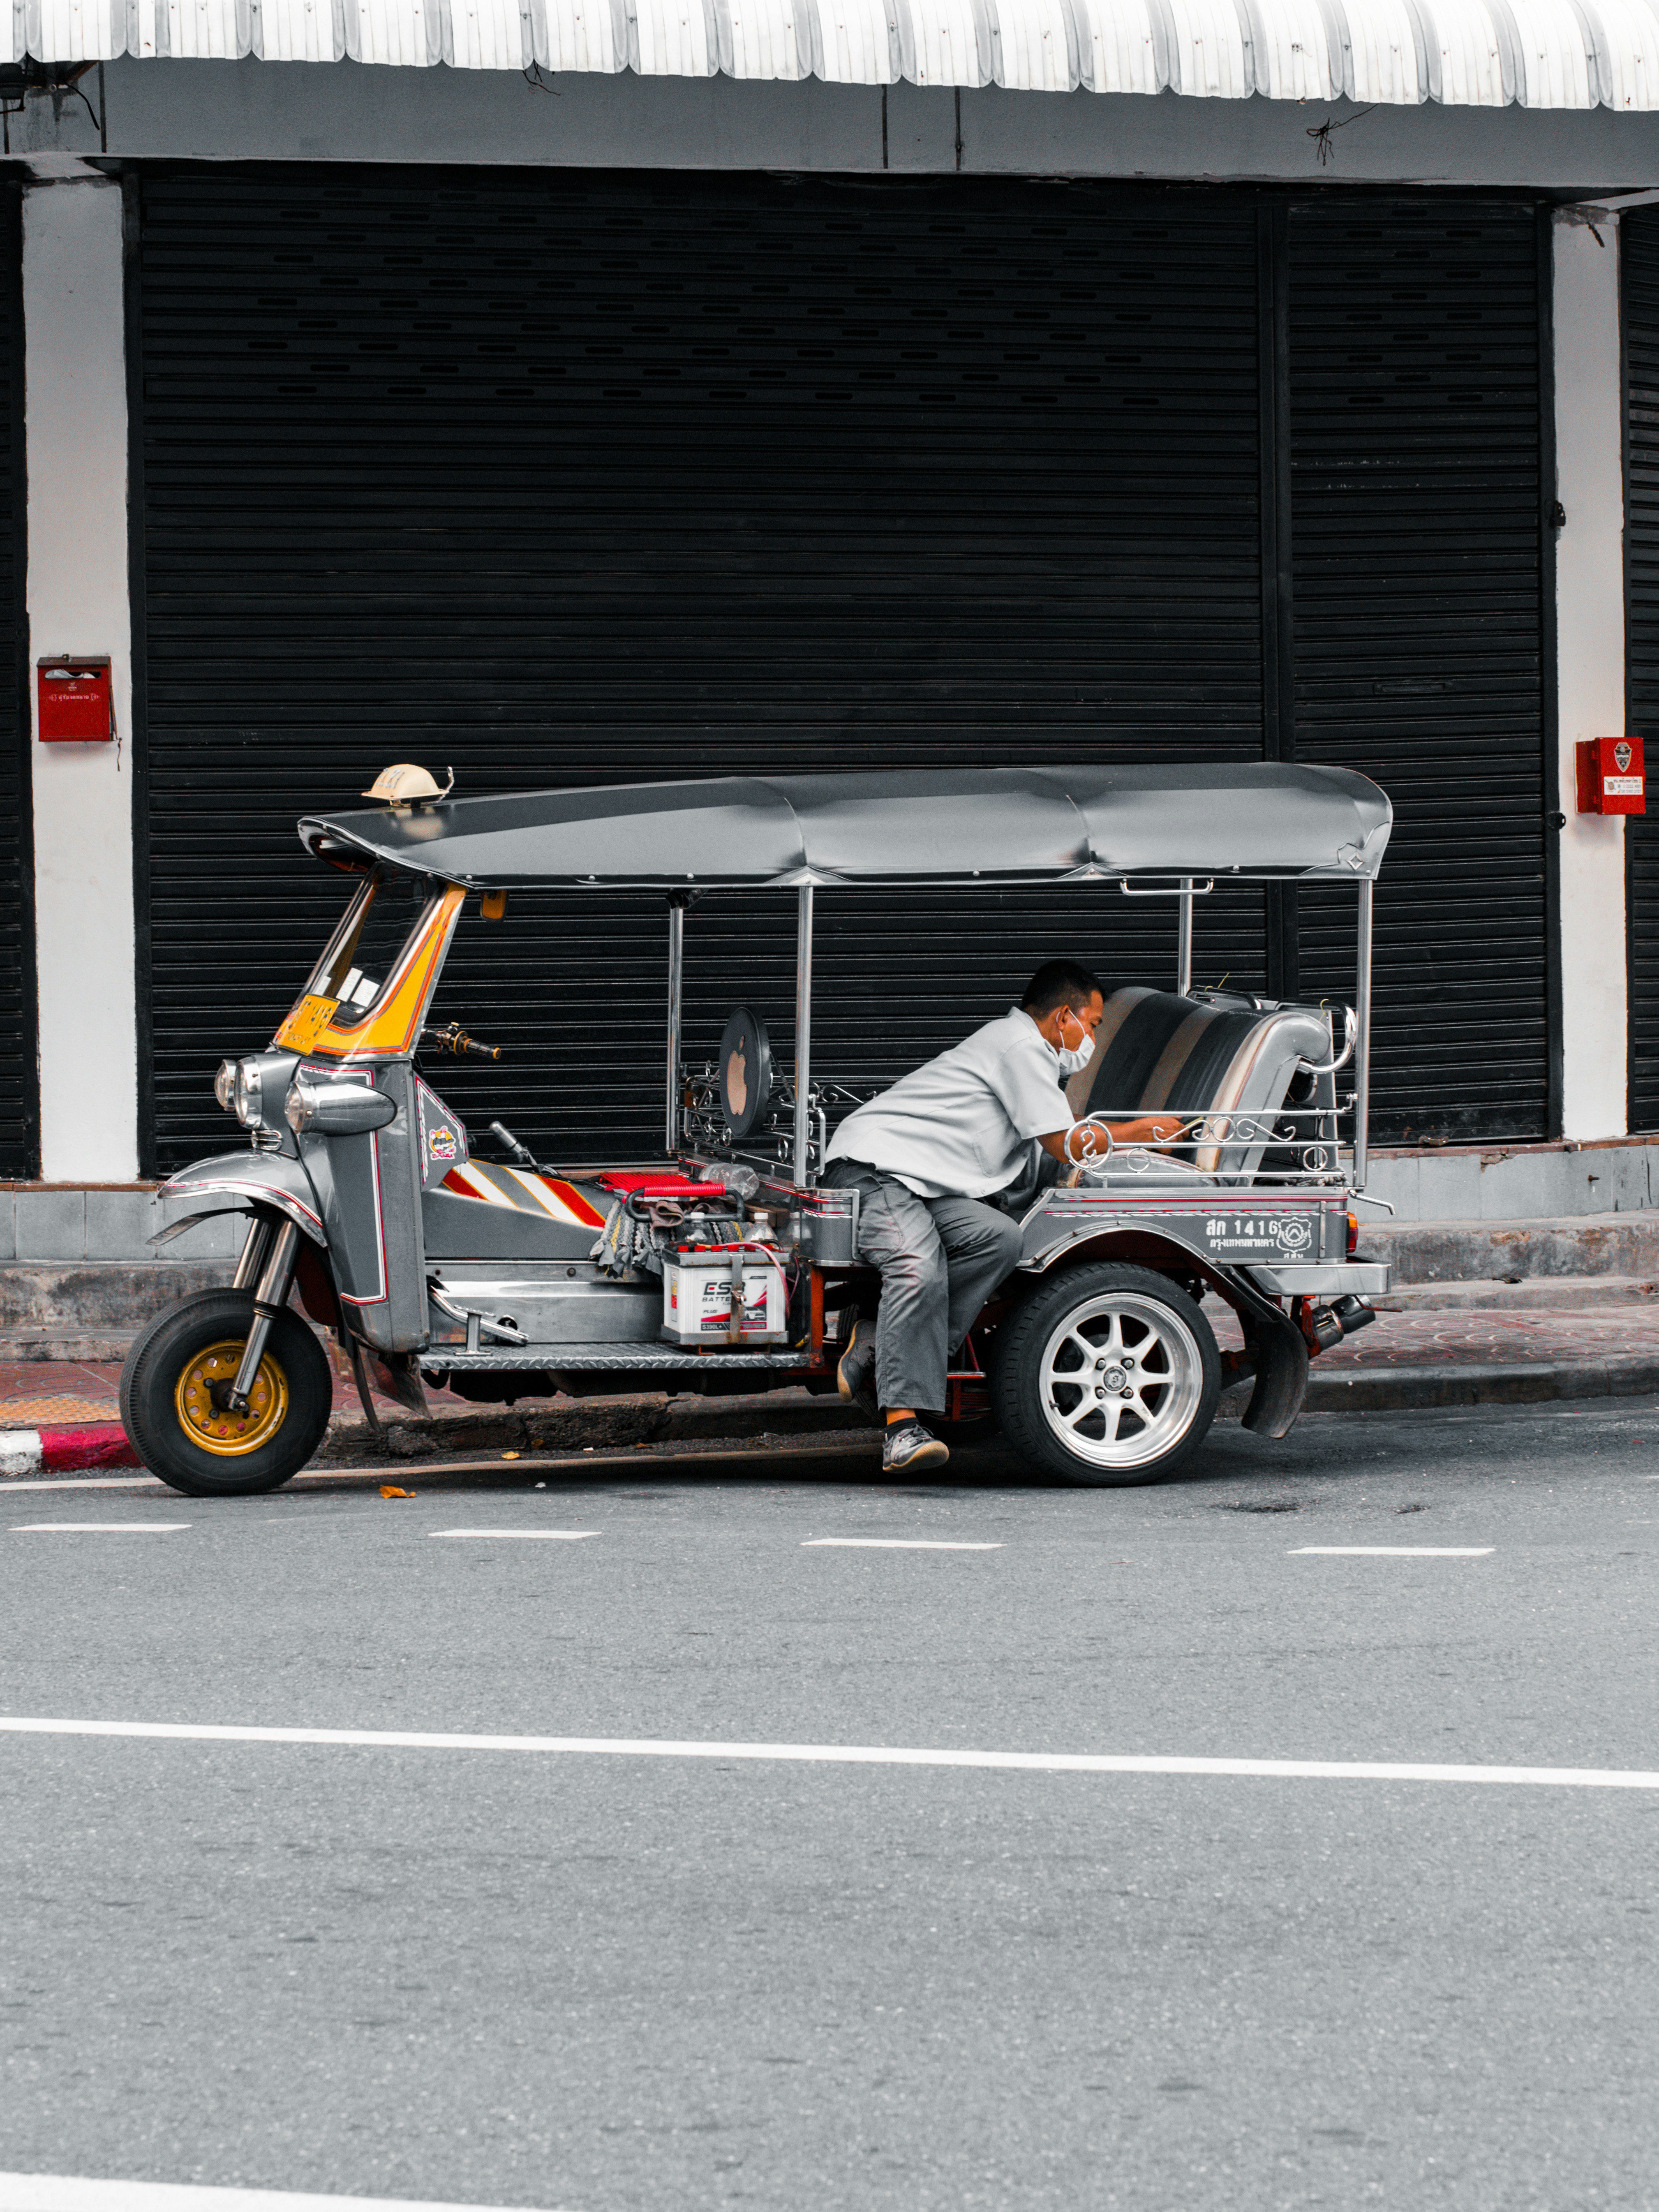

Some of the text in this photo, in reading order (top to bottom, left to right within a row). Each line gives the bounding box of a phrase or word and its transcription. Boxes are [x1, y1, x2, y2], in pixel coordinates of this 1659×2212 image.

[1206, 1219, 1278, 1236] สก 1416
[1210, 1239, 1275, 1251] กรุงเทพมหานคร
